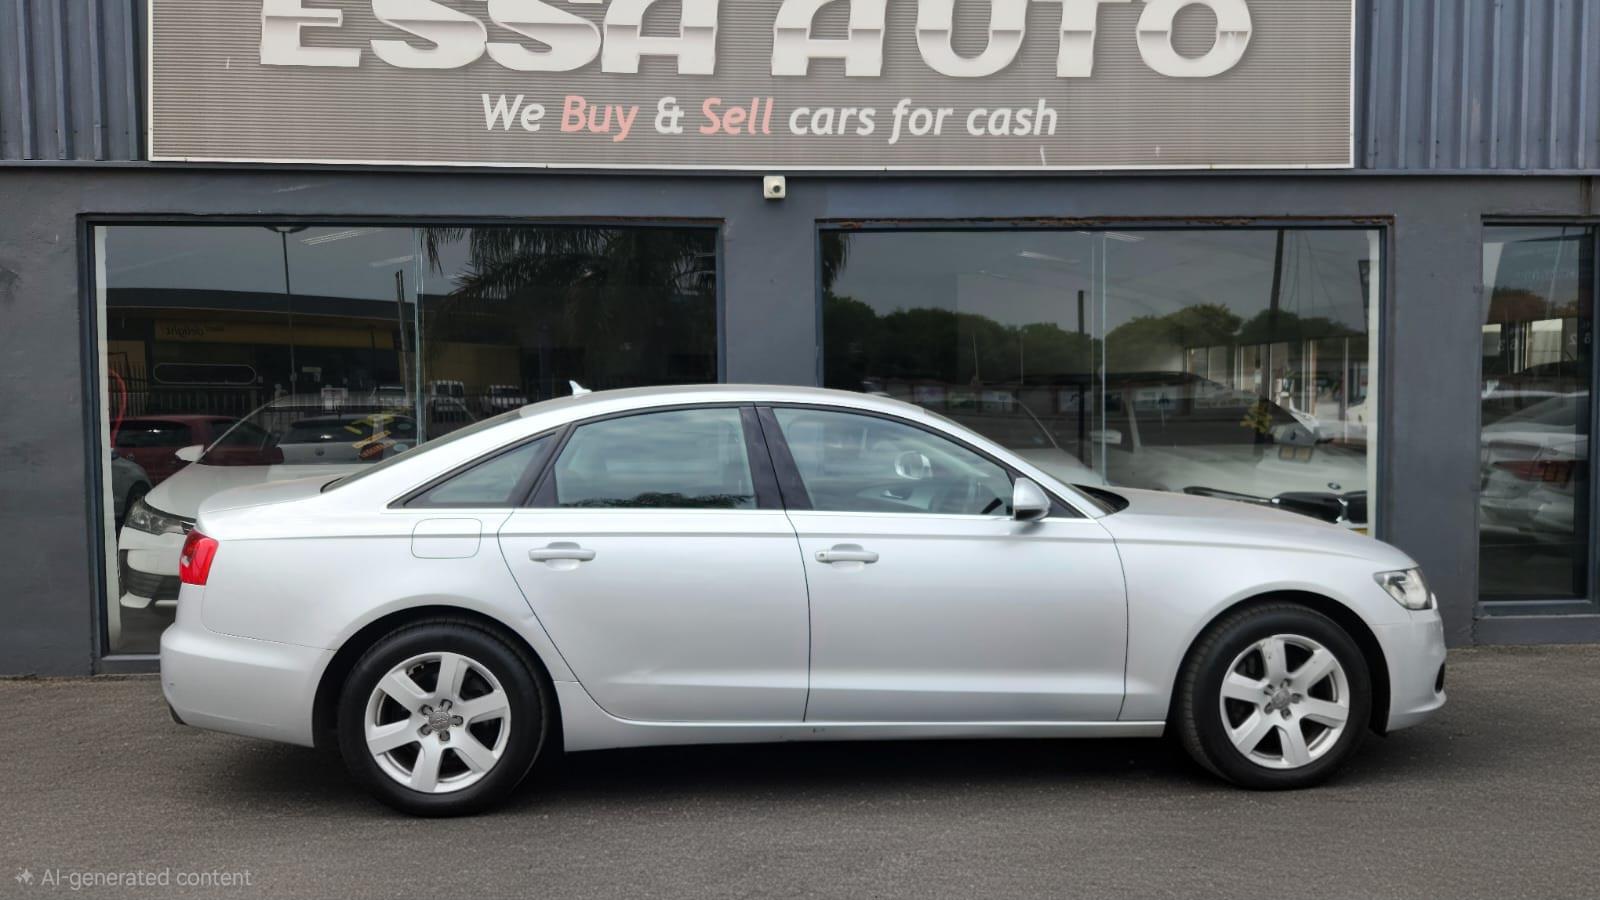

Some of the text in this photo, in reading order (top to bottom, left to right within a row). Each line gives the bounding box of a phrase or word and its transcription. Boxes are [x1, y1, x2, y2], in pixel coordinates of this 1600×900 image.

[259, 0, 1253, 78] ESSA AUTO
[481, 93, 1058, 145] We Buy & Sell cars for cash
